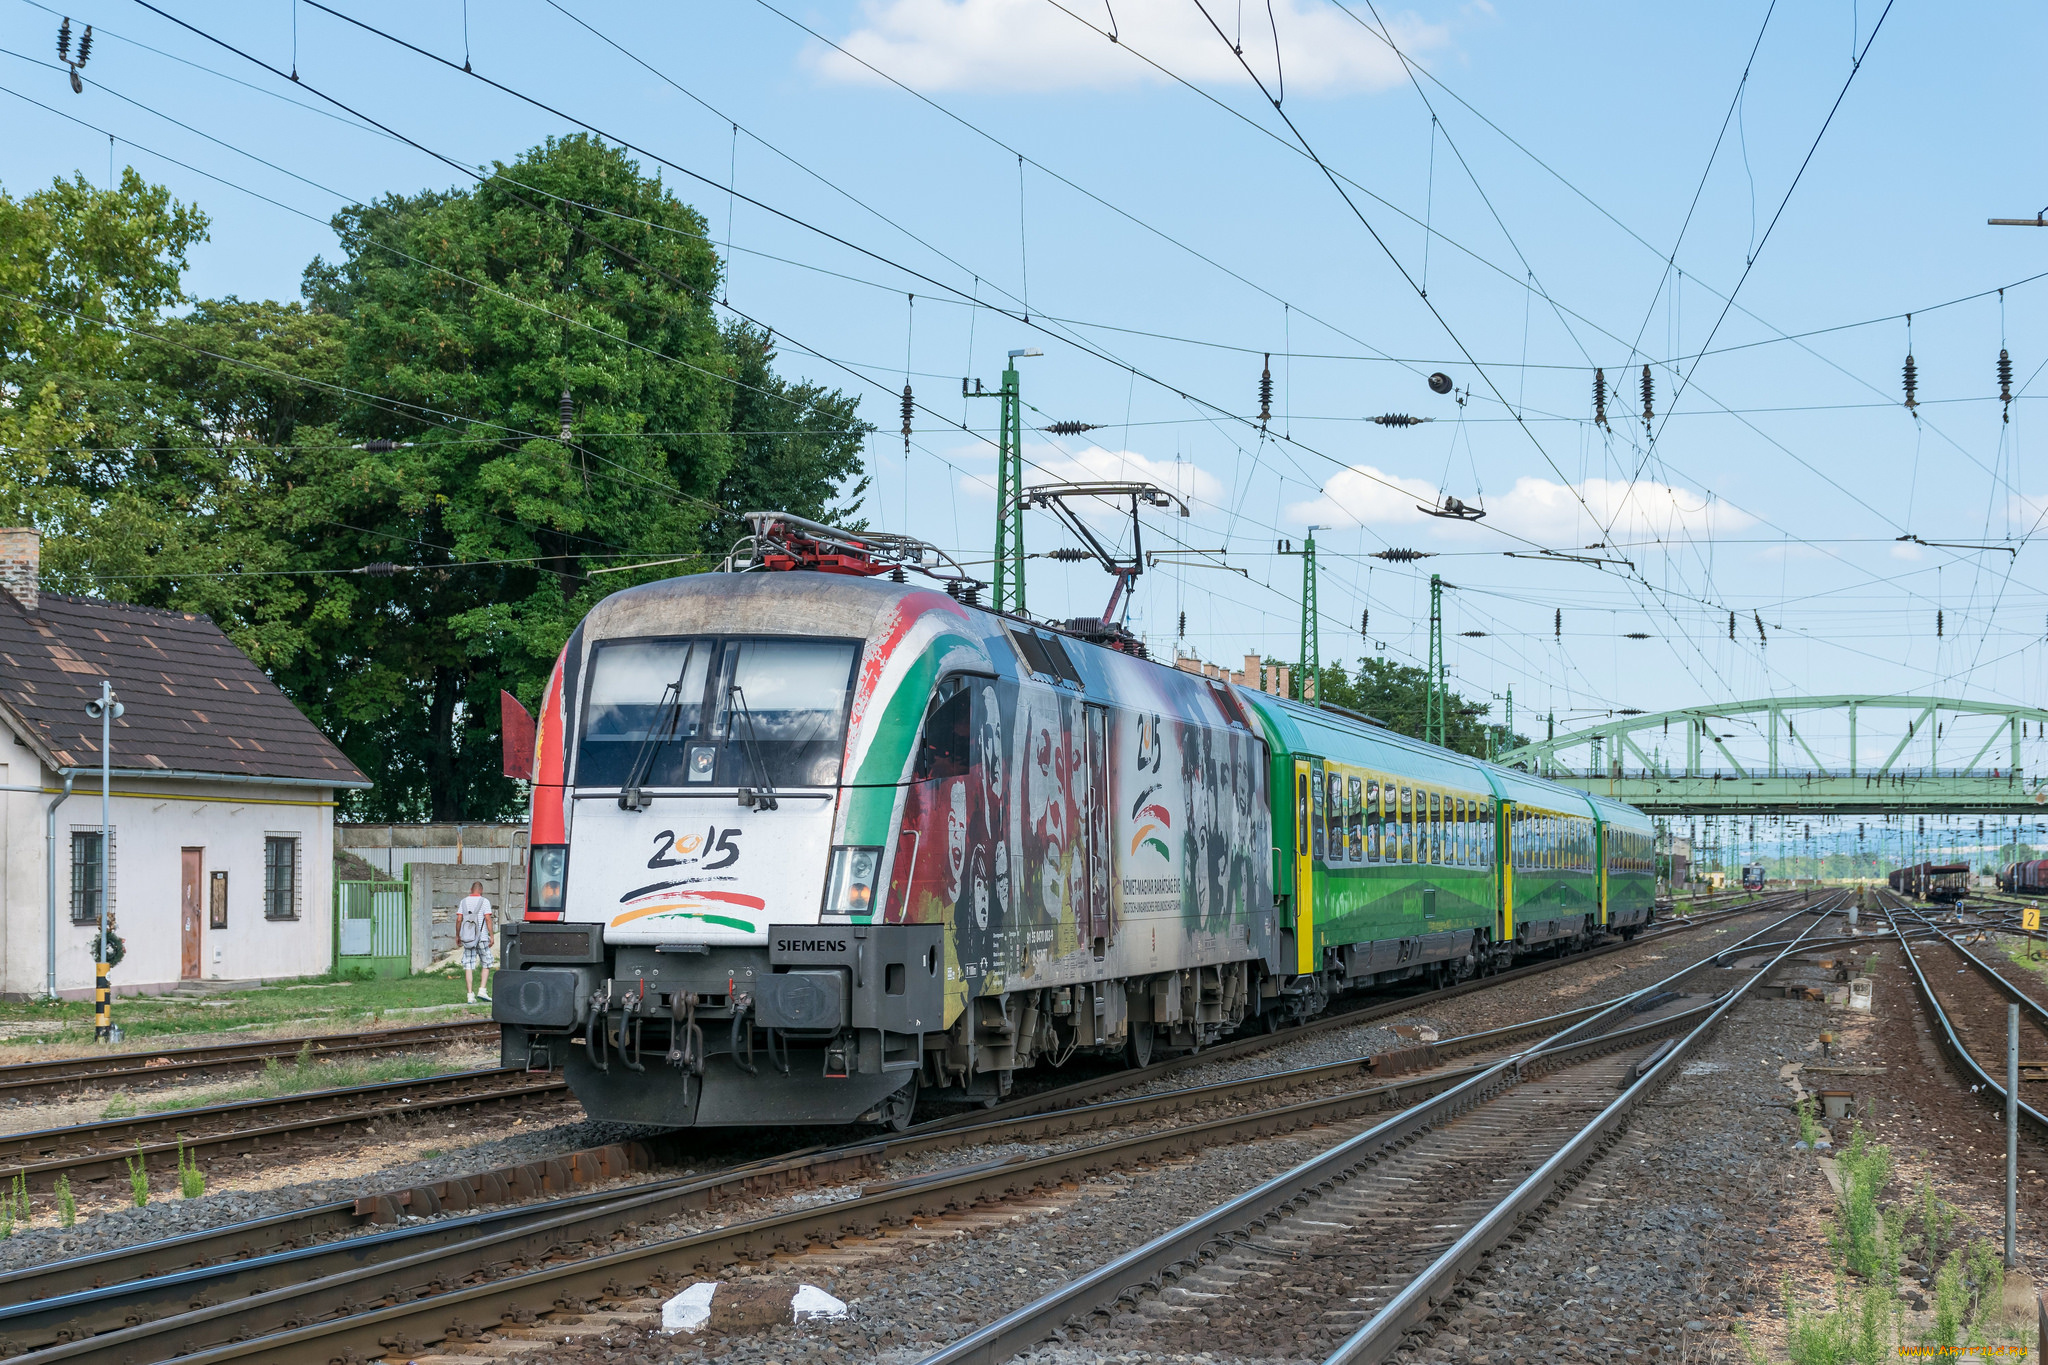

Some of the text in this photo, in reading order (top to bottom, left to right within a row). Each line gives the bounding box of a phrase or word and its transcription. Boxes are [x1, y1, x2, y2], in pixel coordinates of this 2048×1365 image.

[1137, 712, 1161, 774] 2015
[647, 825, 743, 870] 2015
[2027, 912, 2035, 926] 2
[777, 940, 847, 952] SIEMENS
